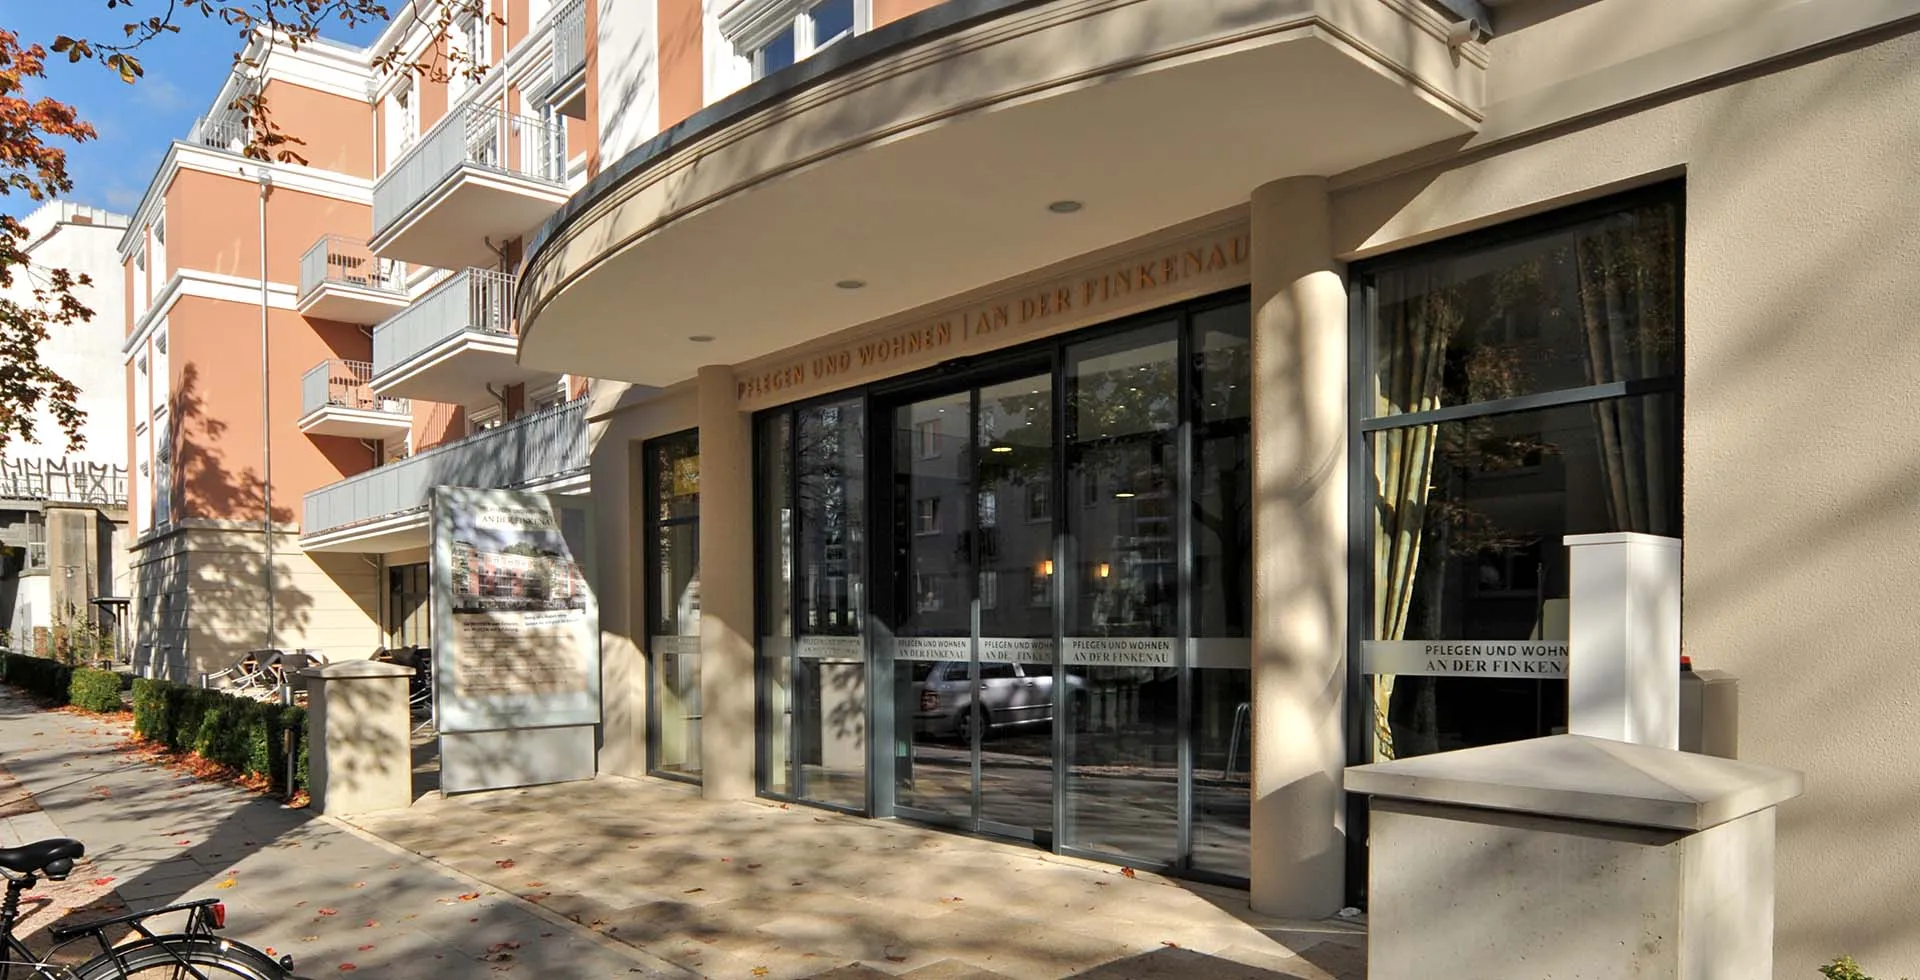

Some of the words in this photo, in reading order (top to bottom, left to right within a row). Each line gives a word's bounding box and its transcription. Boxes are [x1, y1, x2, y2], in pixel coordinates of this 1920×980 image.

[737, 364, 805, 400] PFLEGEN
[812, 351, 850, 379] UND
[858, 322, 952, 368] WOHNEN
[975, 306, 1009, 335] AN
[1019, 285, 1072, 324] DER
[1081, 234, 1251, 307] FINKENAU
[923, 640, 937, 648] UND
[938, 640, 966, 648] WOHNEN
[984, 640, 1013, 649] PFLEGEN
[1014, 641, 1030, 649] UND
[1072, 640, 1106, 649] PFLEGEN
[1108, 640, 1127, 650] UND
[1129, 641, 1170, 650] WOHNEN
[899, 649, 909, 657] AN
[910, 649, 925, 658] DER
[926, 650, 965, 659] FINKENAU
[985, 651, 998, 660] AN
[1425, 645, 1481, 656] PFLEGEN
[1486, 645, 1517, 656] UND
[1521, 645, 1569, 657] WOHN
[1073, 652, 1087, 661] AN
[1089, 652, 1110, 662] DER
[1112, 652, 1169, 663] FINKENAU
[1425, 659, 1449, 672] AN
[1452, 659, 1487, 672] DER
